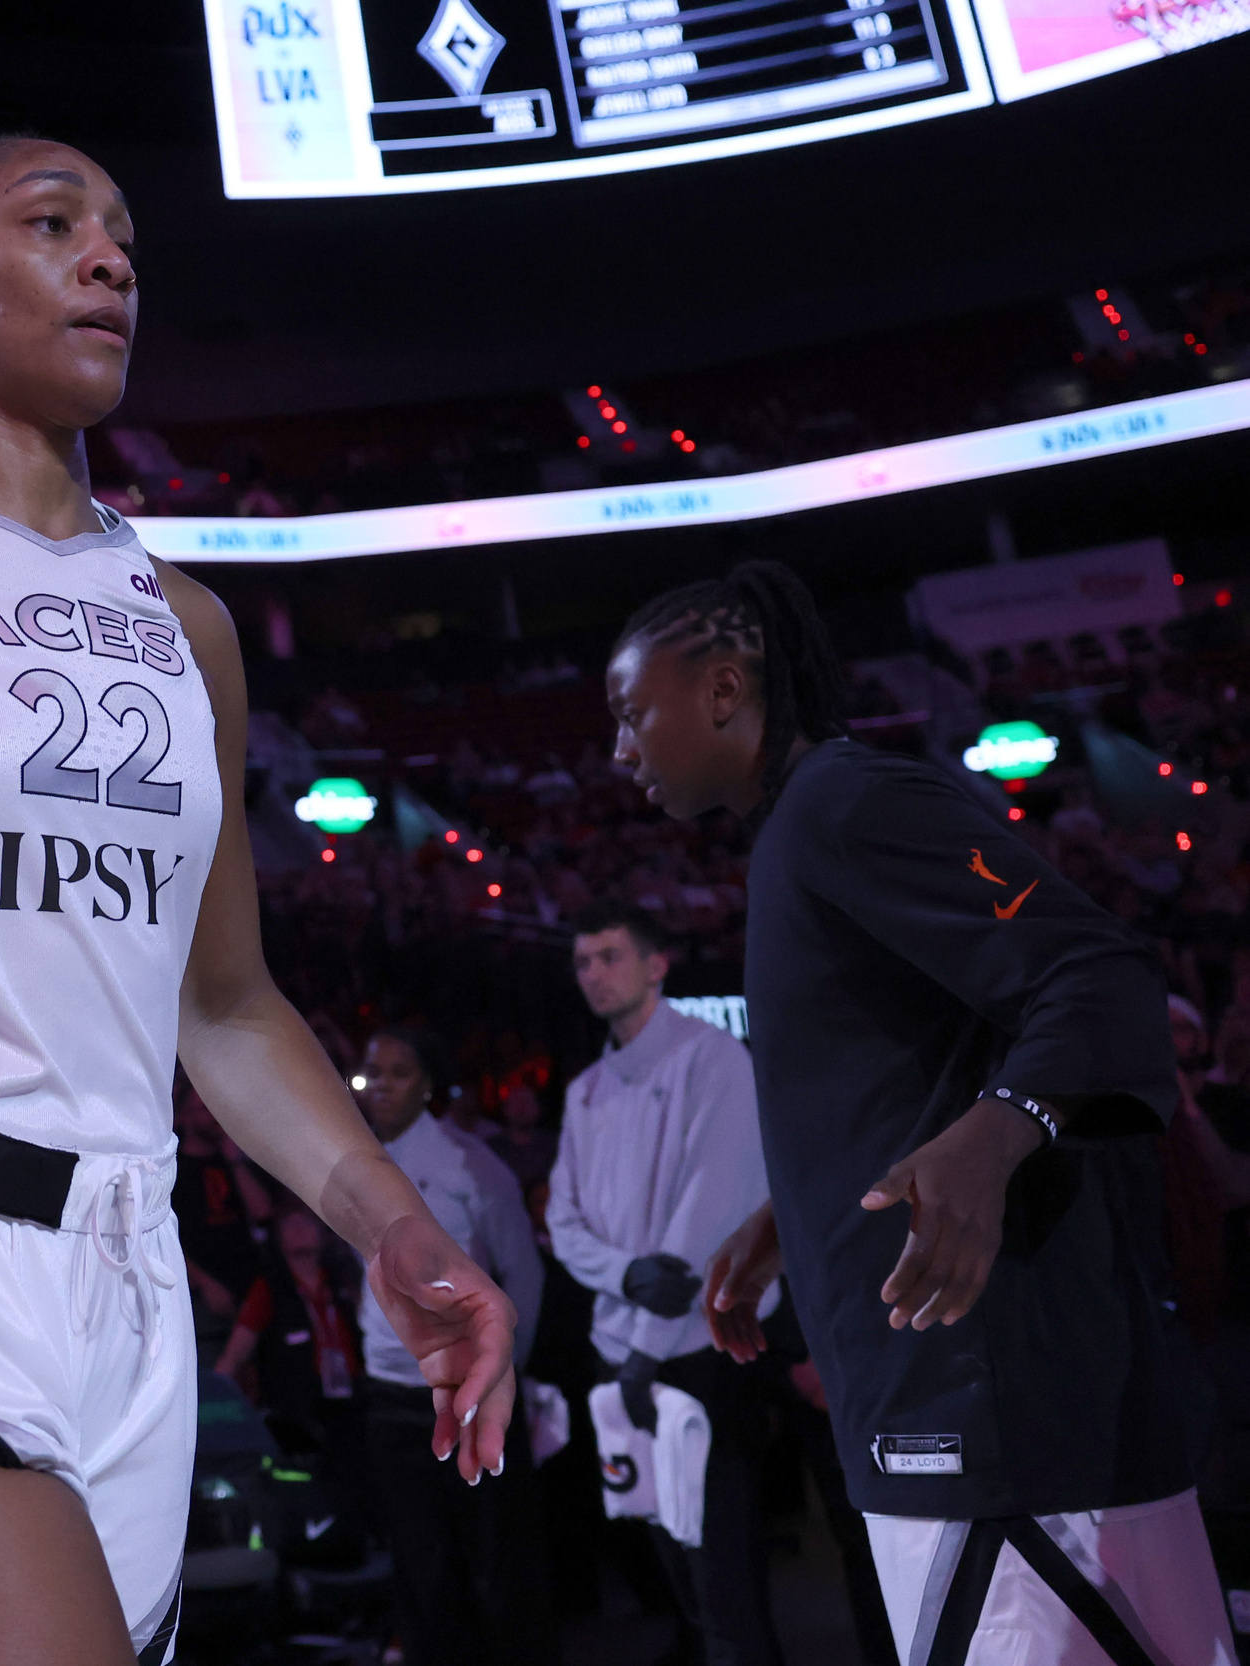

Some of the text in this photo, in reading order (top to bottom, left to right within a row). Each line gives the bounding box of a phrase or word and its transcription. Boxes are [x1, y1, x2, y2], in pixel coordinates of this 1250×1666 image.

[257, 69, 319, 103] LVA
[8, 668, 183, 816] 22
[900, 1457, 945, 1467] 24 LOYD
